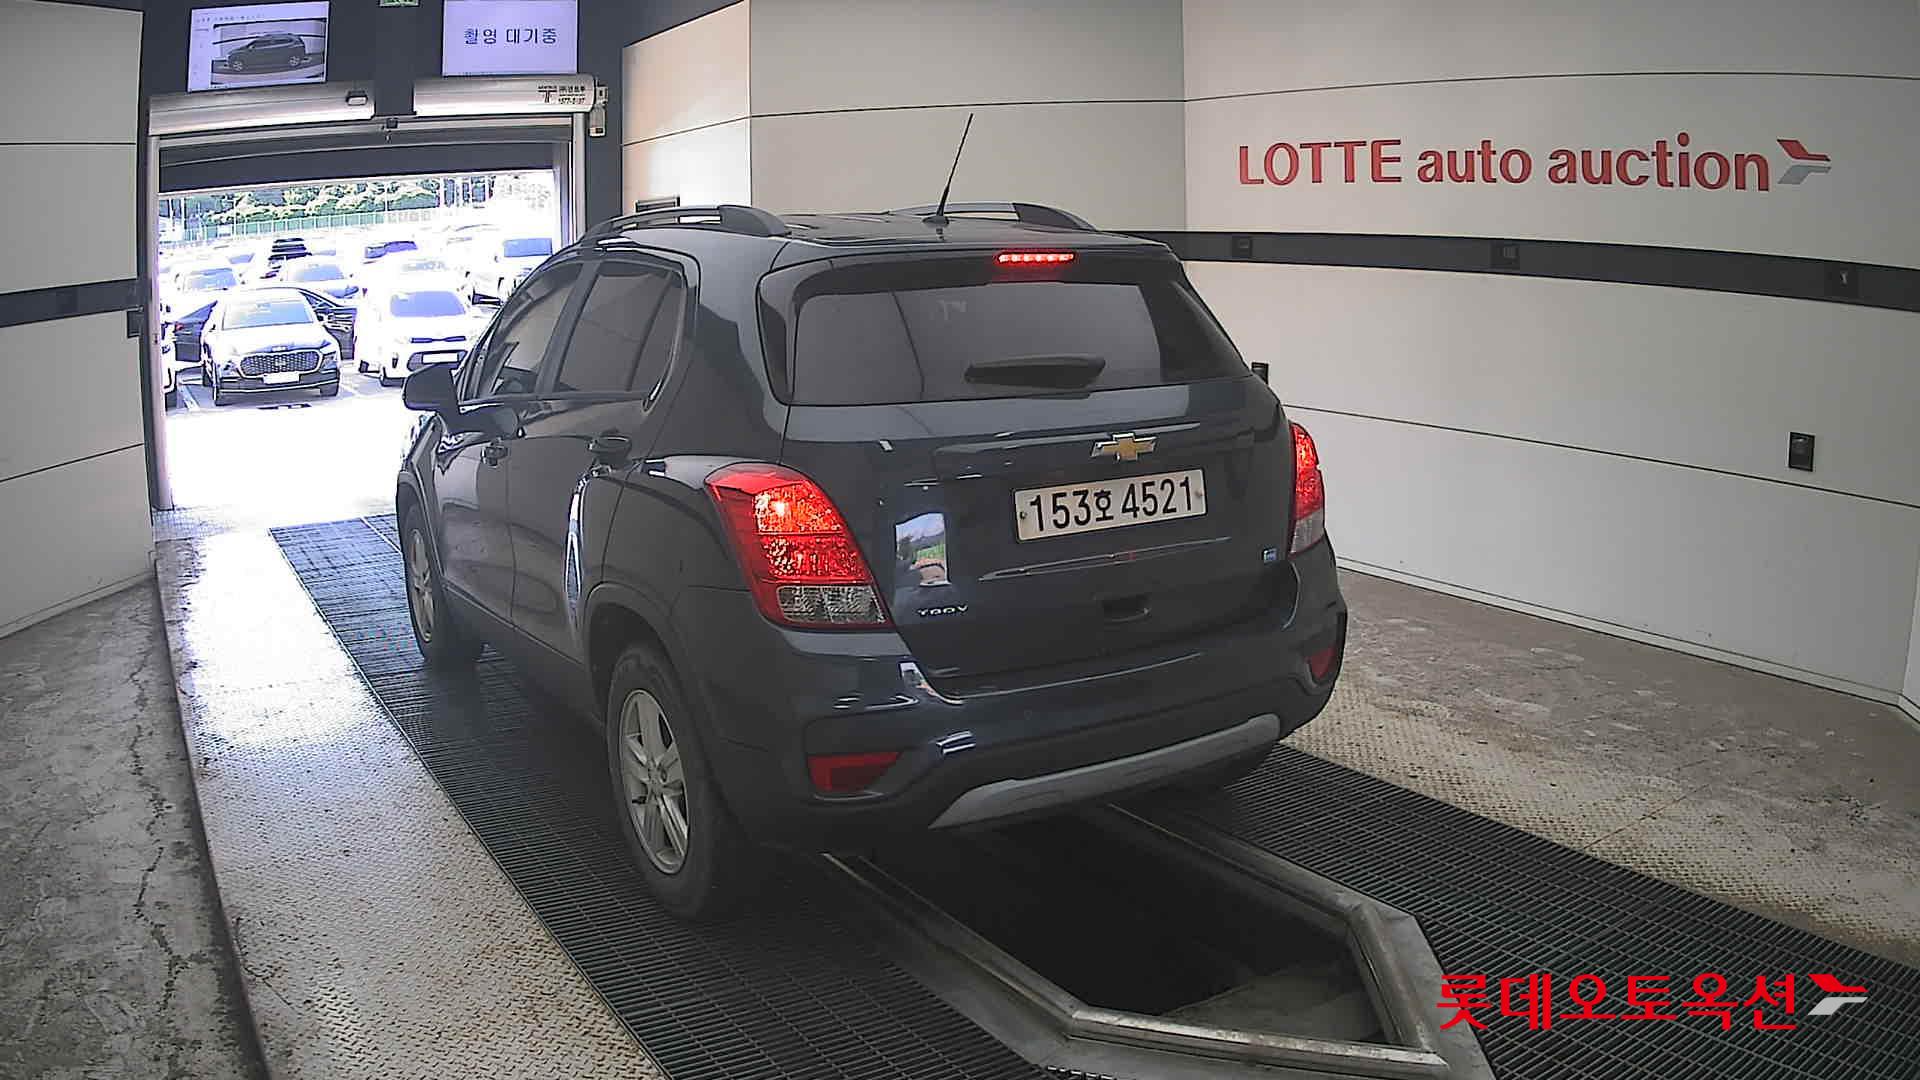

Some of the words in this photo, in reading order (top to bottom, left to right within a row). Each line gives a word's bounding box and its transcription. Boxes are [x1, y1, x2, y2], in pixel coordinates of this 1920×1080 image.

[506, 28, 557, 44] 대기중
[1238, 138, 1401, 187] LOTTE
[1417, 139, 1533, 185] auto
[1548, 132, 1770, 191] auction
[1030, 489, 1114, 532] 153호
[1121, 476, 1192, 519] 4521
